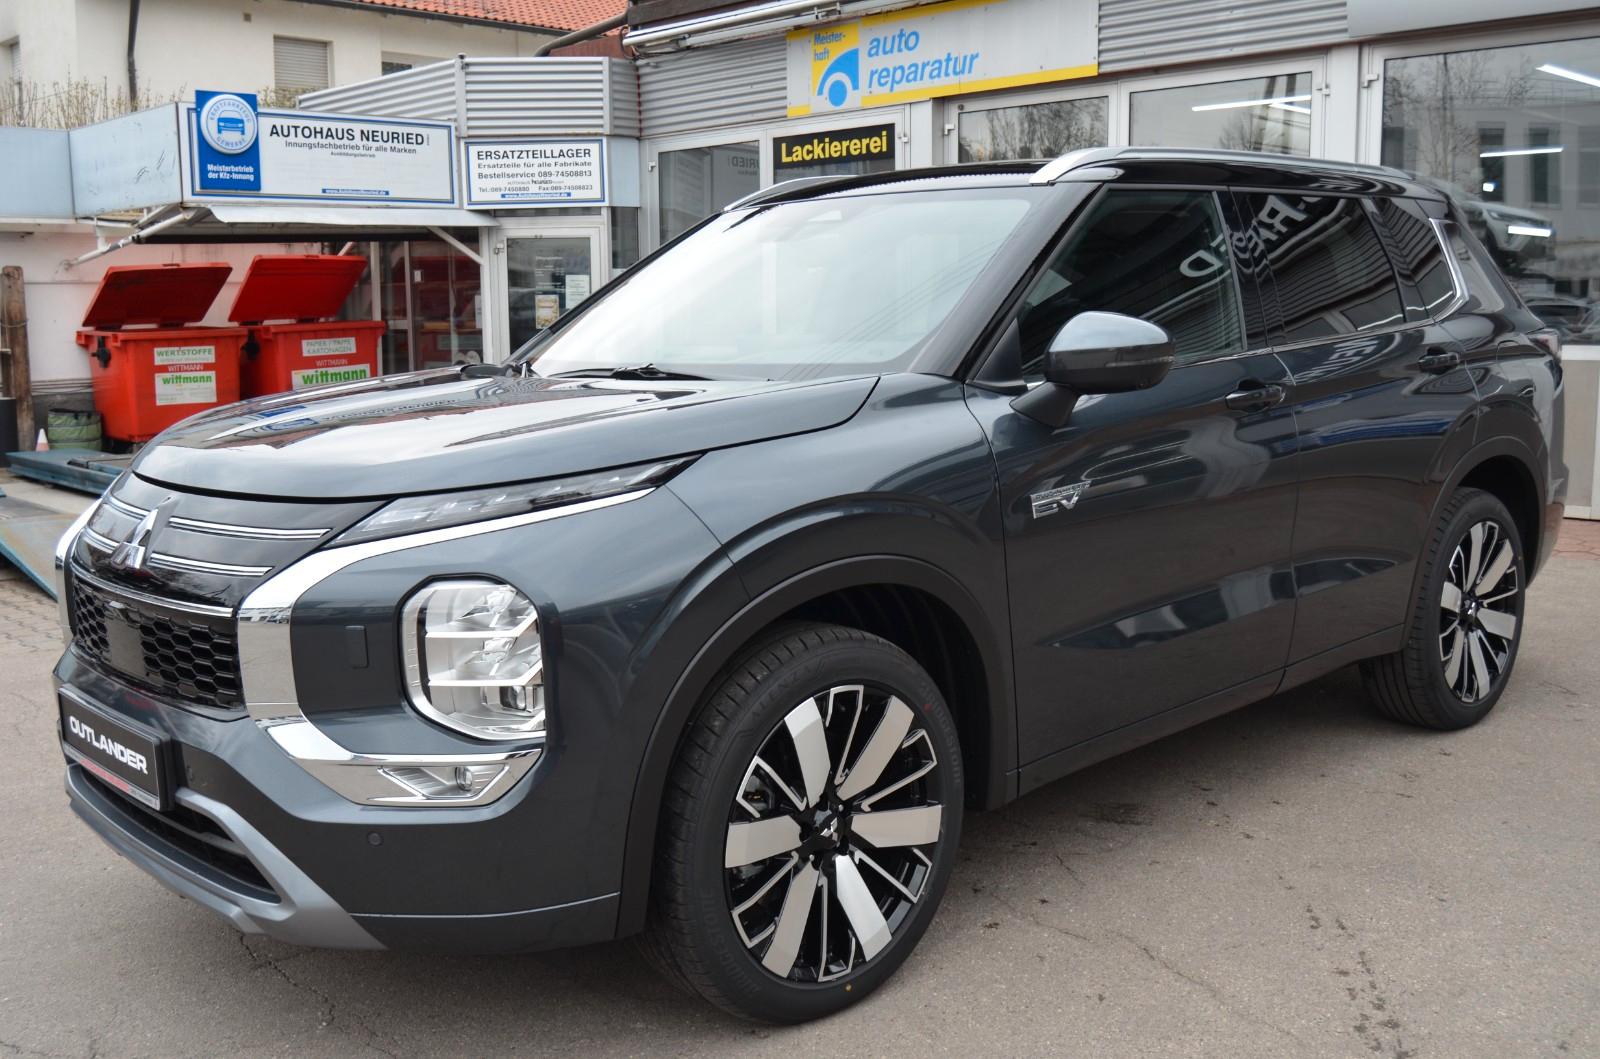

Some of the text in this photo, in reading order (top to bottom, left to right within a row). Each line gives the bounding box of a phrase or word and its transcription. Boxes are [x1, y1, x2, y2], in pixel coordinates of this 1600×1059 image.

[813, 31, 846, 46] Meister-
[866, 28, 920, 57] auto
[813, 48, 830, 62] haft
[868, 52, 979, 92] reparatur
[269, 124, 355, 142] AUTOHAUS
[360, 129, 425, 146] NEURIED
[285, 140, 417, 154] Innungsfachbetrieb für alle Marken
[781, 131, 888, 163] Lackiererei
[477, 148, 591, 160] ERSATZTEILLAGER
[207, 164, 254, 173] Meisterbetrieb
[554, 160, 592, 168] Fabrikate
[219, 172, 255, 182] Kfz-Innung
[478, 171, 536, 180] Bestellservice
[156, 348, 213, 357] WERTSTOFFE
[167, 363, 204, 372] WITTMANN
[315, 359, 348, 367] WITTMANN
[162, 374, 212, 385] wittmann
[302, 368, 367, 385] wittmann
[69, 715, 148, 775] OUTLANDER
